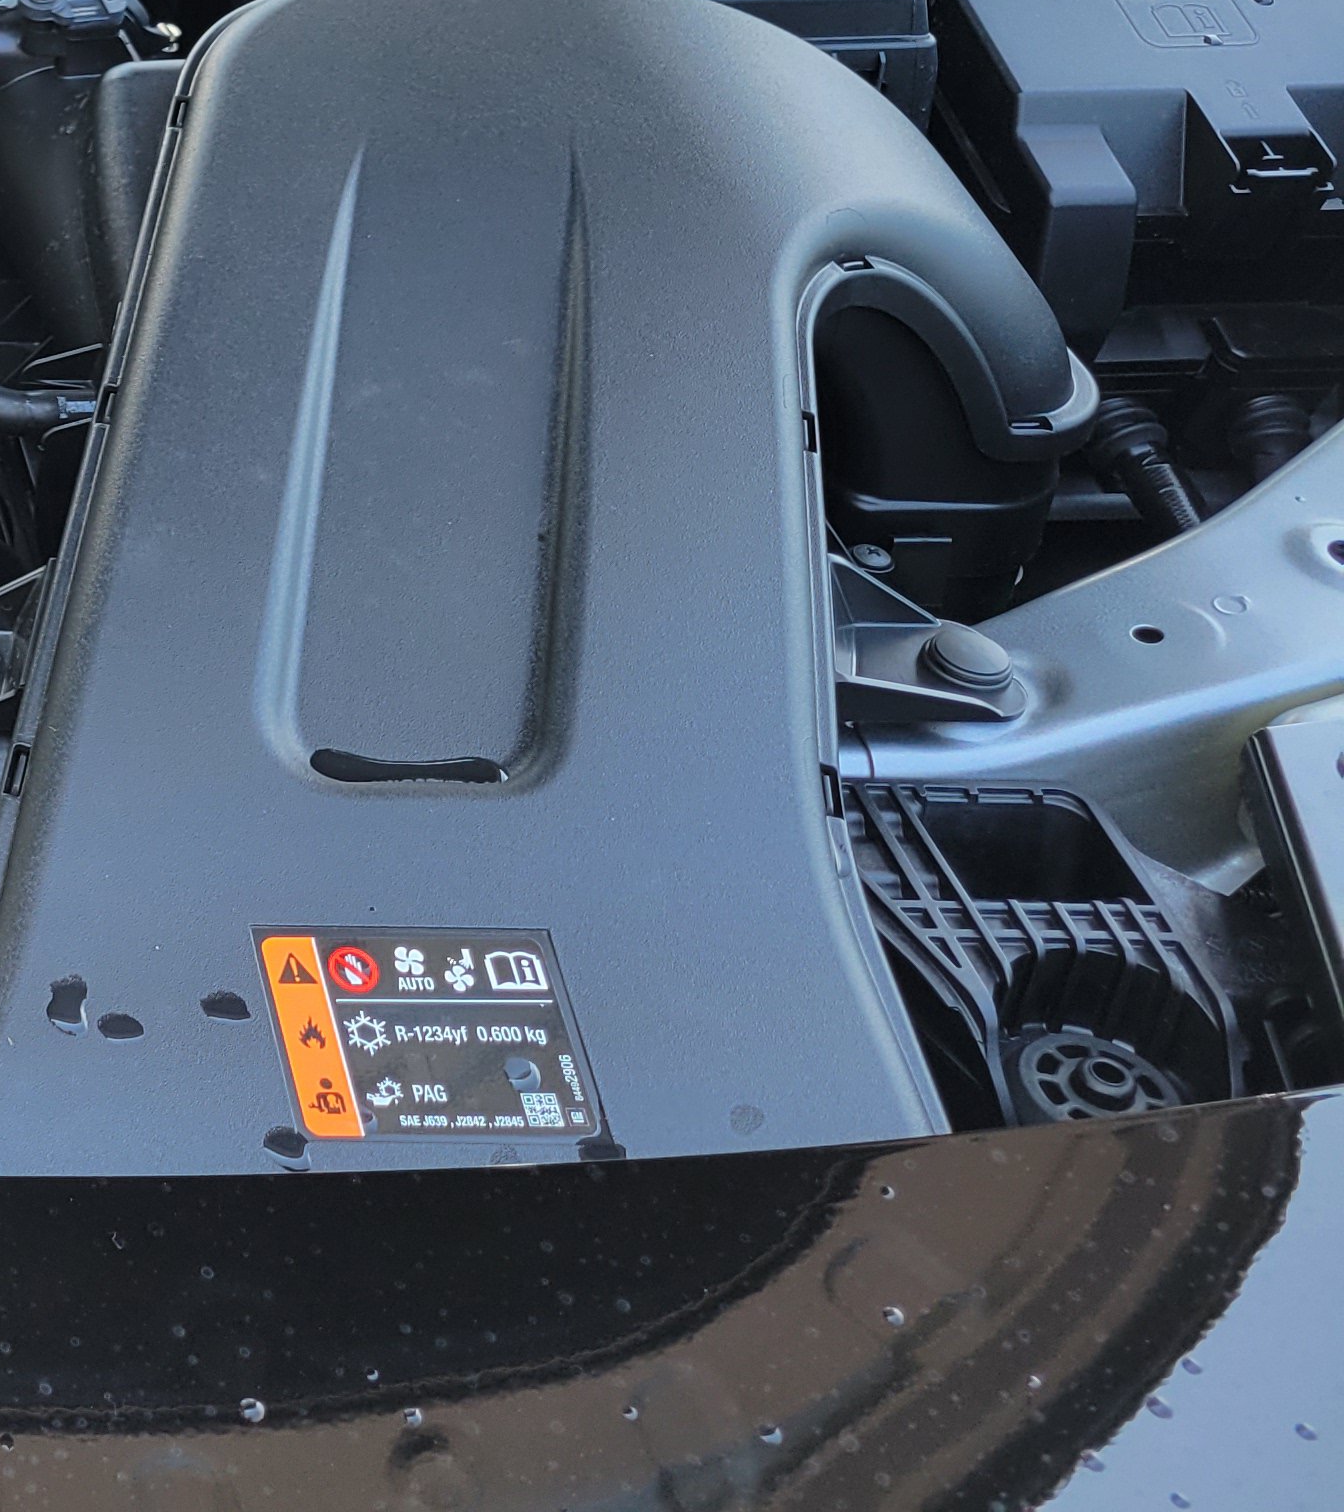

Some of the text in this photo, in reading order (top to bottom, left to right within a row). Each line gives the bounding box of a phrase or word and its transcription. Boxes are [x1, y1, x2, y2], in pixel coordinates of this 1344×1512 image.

[398, 976, 434, 991] AUTO
[394, 1025, 548, 1046] R-1234yf 0.600 kg
[412, 1084, 448, 1104] PAG
[399, 1114, 421, 1127] SAE
